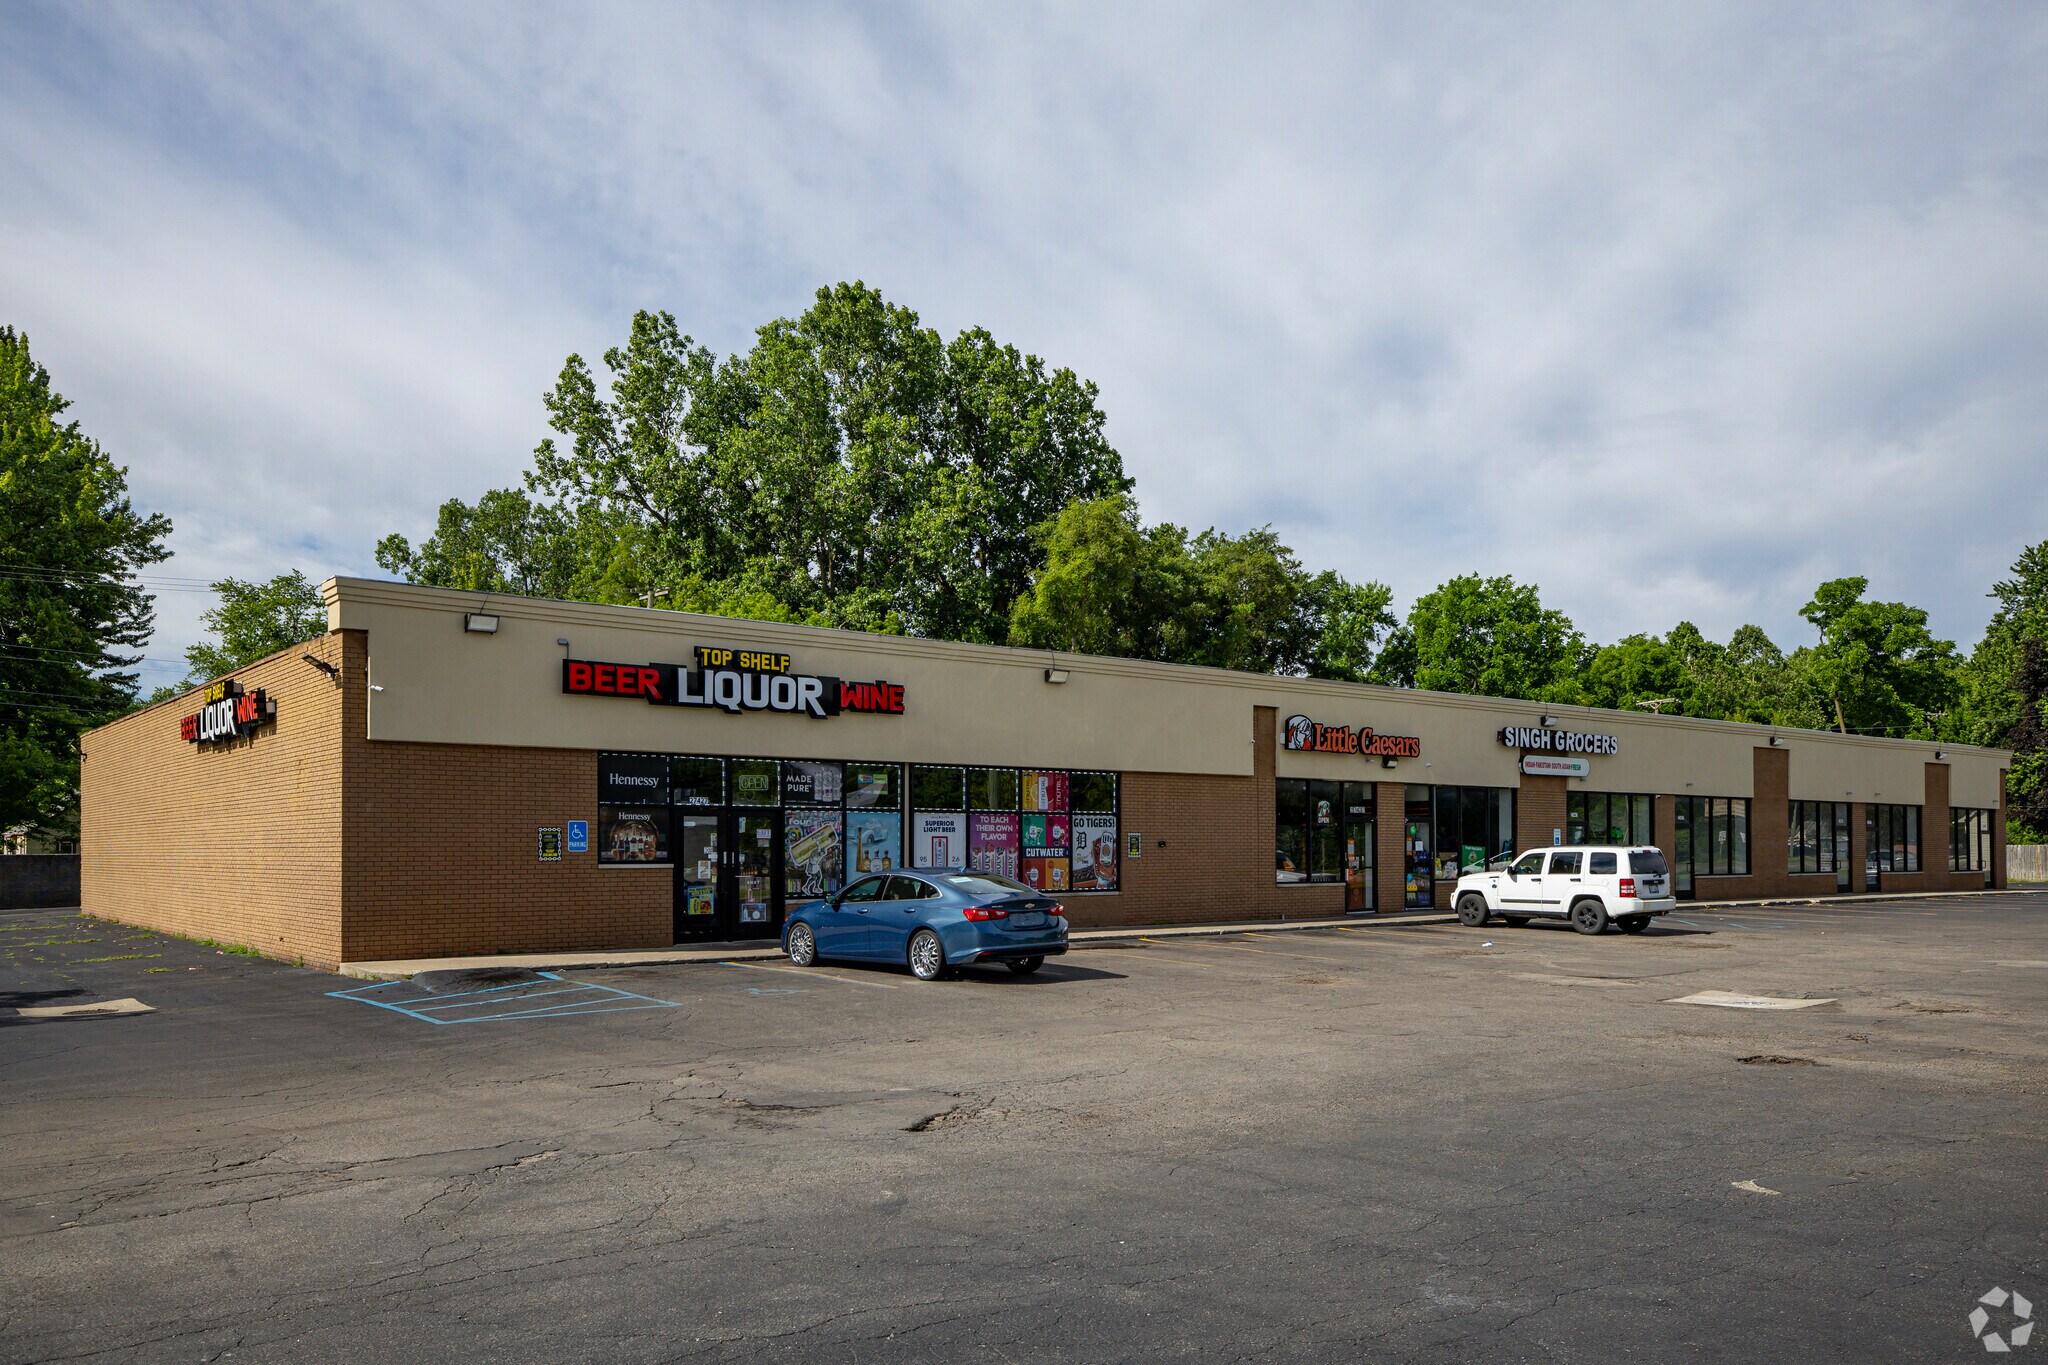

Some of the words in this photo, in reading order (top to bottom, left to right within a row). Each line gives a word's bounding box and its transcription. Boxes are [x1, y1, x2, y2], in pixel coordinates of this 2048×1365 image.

[701, 648, 732, 666] TOP
[740, 652, 790, 672] SHELF
[204, 687, 213, 703] TOP
[213, 681, 225, 700] SHELF
[568, 662, 662, 698] BEER
[677, 667, 826, 716] LIQUOR
[840, 681, 905, 712] WINE
[181, 715, 197, 740] BEER
[200, 698, 236, 741] LIQUOR
[237, 692, 258, 724] WINE
[1314, 724, 1358, 754] Little
[1361, 727, 1420, 757] Caesars
[1505, 727, 1551, 750] SINGH
[1555, 730, 1618, 755] GROCERS
[609, 773, 660, 788] Hennessy
[740, 776, 768, 789] OPEN
[786, 774, 812, 783] MADE
[618, 812, 651, 822] Hennessy
[991, 816, 1009, 824] EACH
[1073, 818, 1085, 828] GO
[1086, 818, 1115, 828] TIGERS!
[976, 824, 995, 832] THEIR
[981, 833, 1007, 841] FLAVOR
[1026, 848, 1064, 857] CUTWATER
